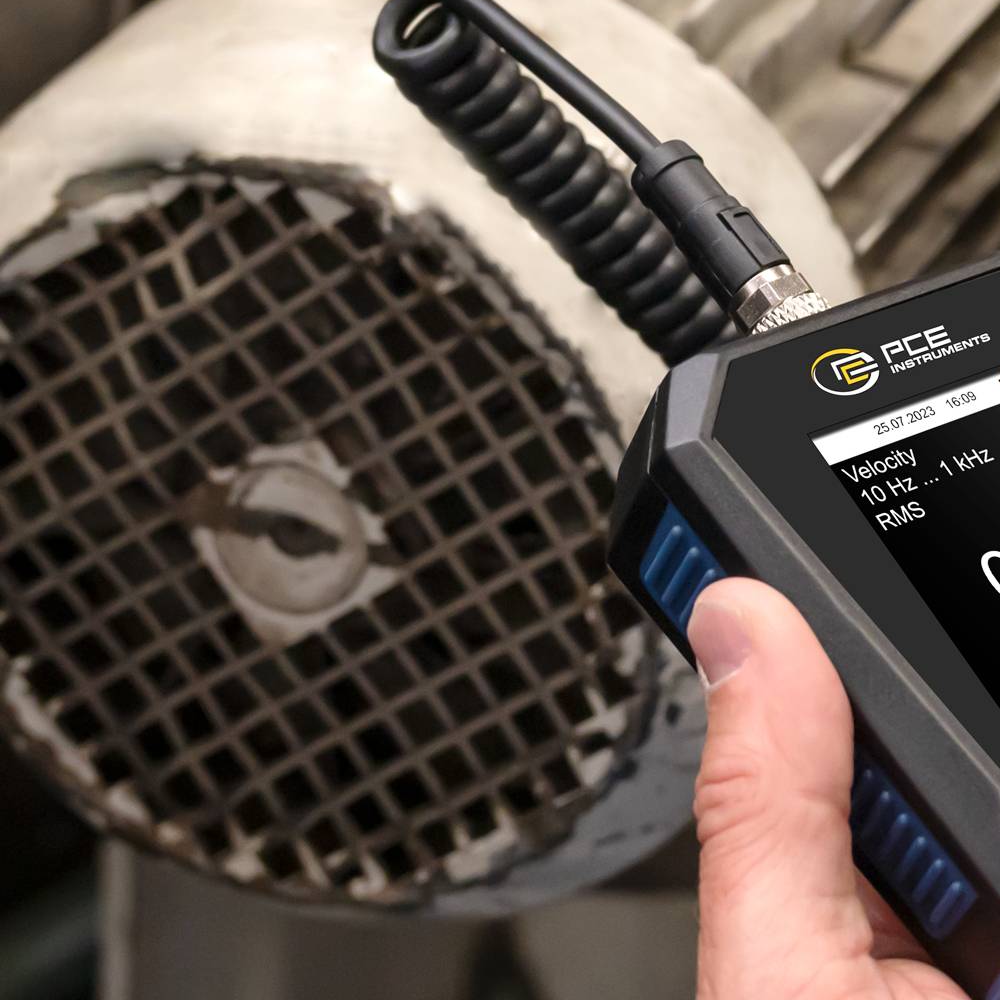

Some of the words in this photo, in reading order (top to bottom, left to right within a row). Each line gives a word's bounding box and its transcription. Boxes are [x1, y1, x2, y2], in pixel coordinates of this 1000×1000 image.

[880, 325, 951, 362] PCE
[890, 333, 991, 373] INSTRUMENTS
[873, 406, 936, 435] 25.07.2023
[945, 391, 977, 409] 16:09
[842, 446, 918, 484] Velocity
[860, 484, 886, 506] 10
[885, 475, 918, 498] Hz
[939, 461, 954, 479] 1
[951, 446, 994, 474] kHz
[876, 502, 926, 531] RMS
